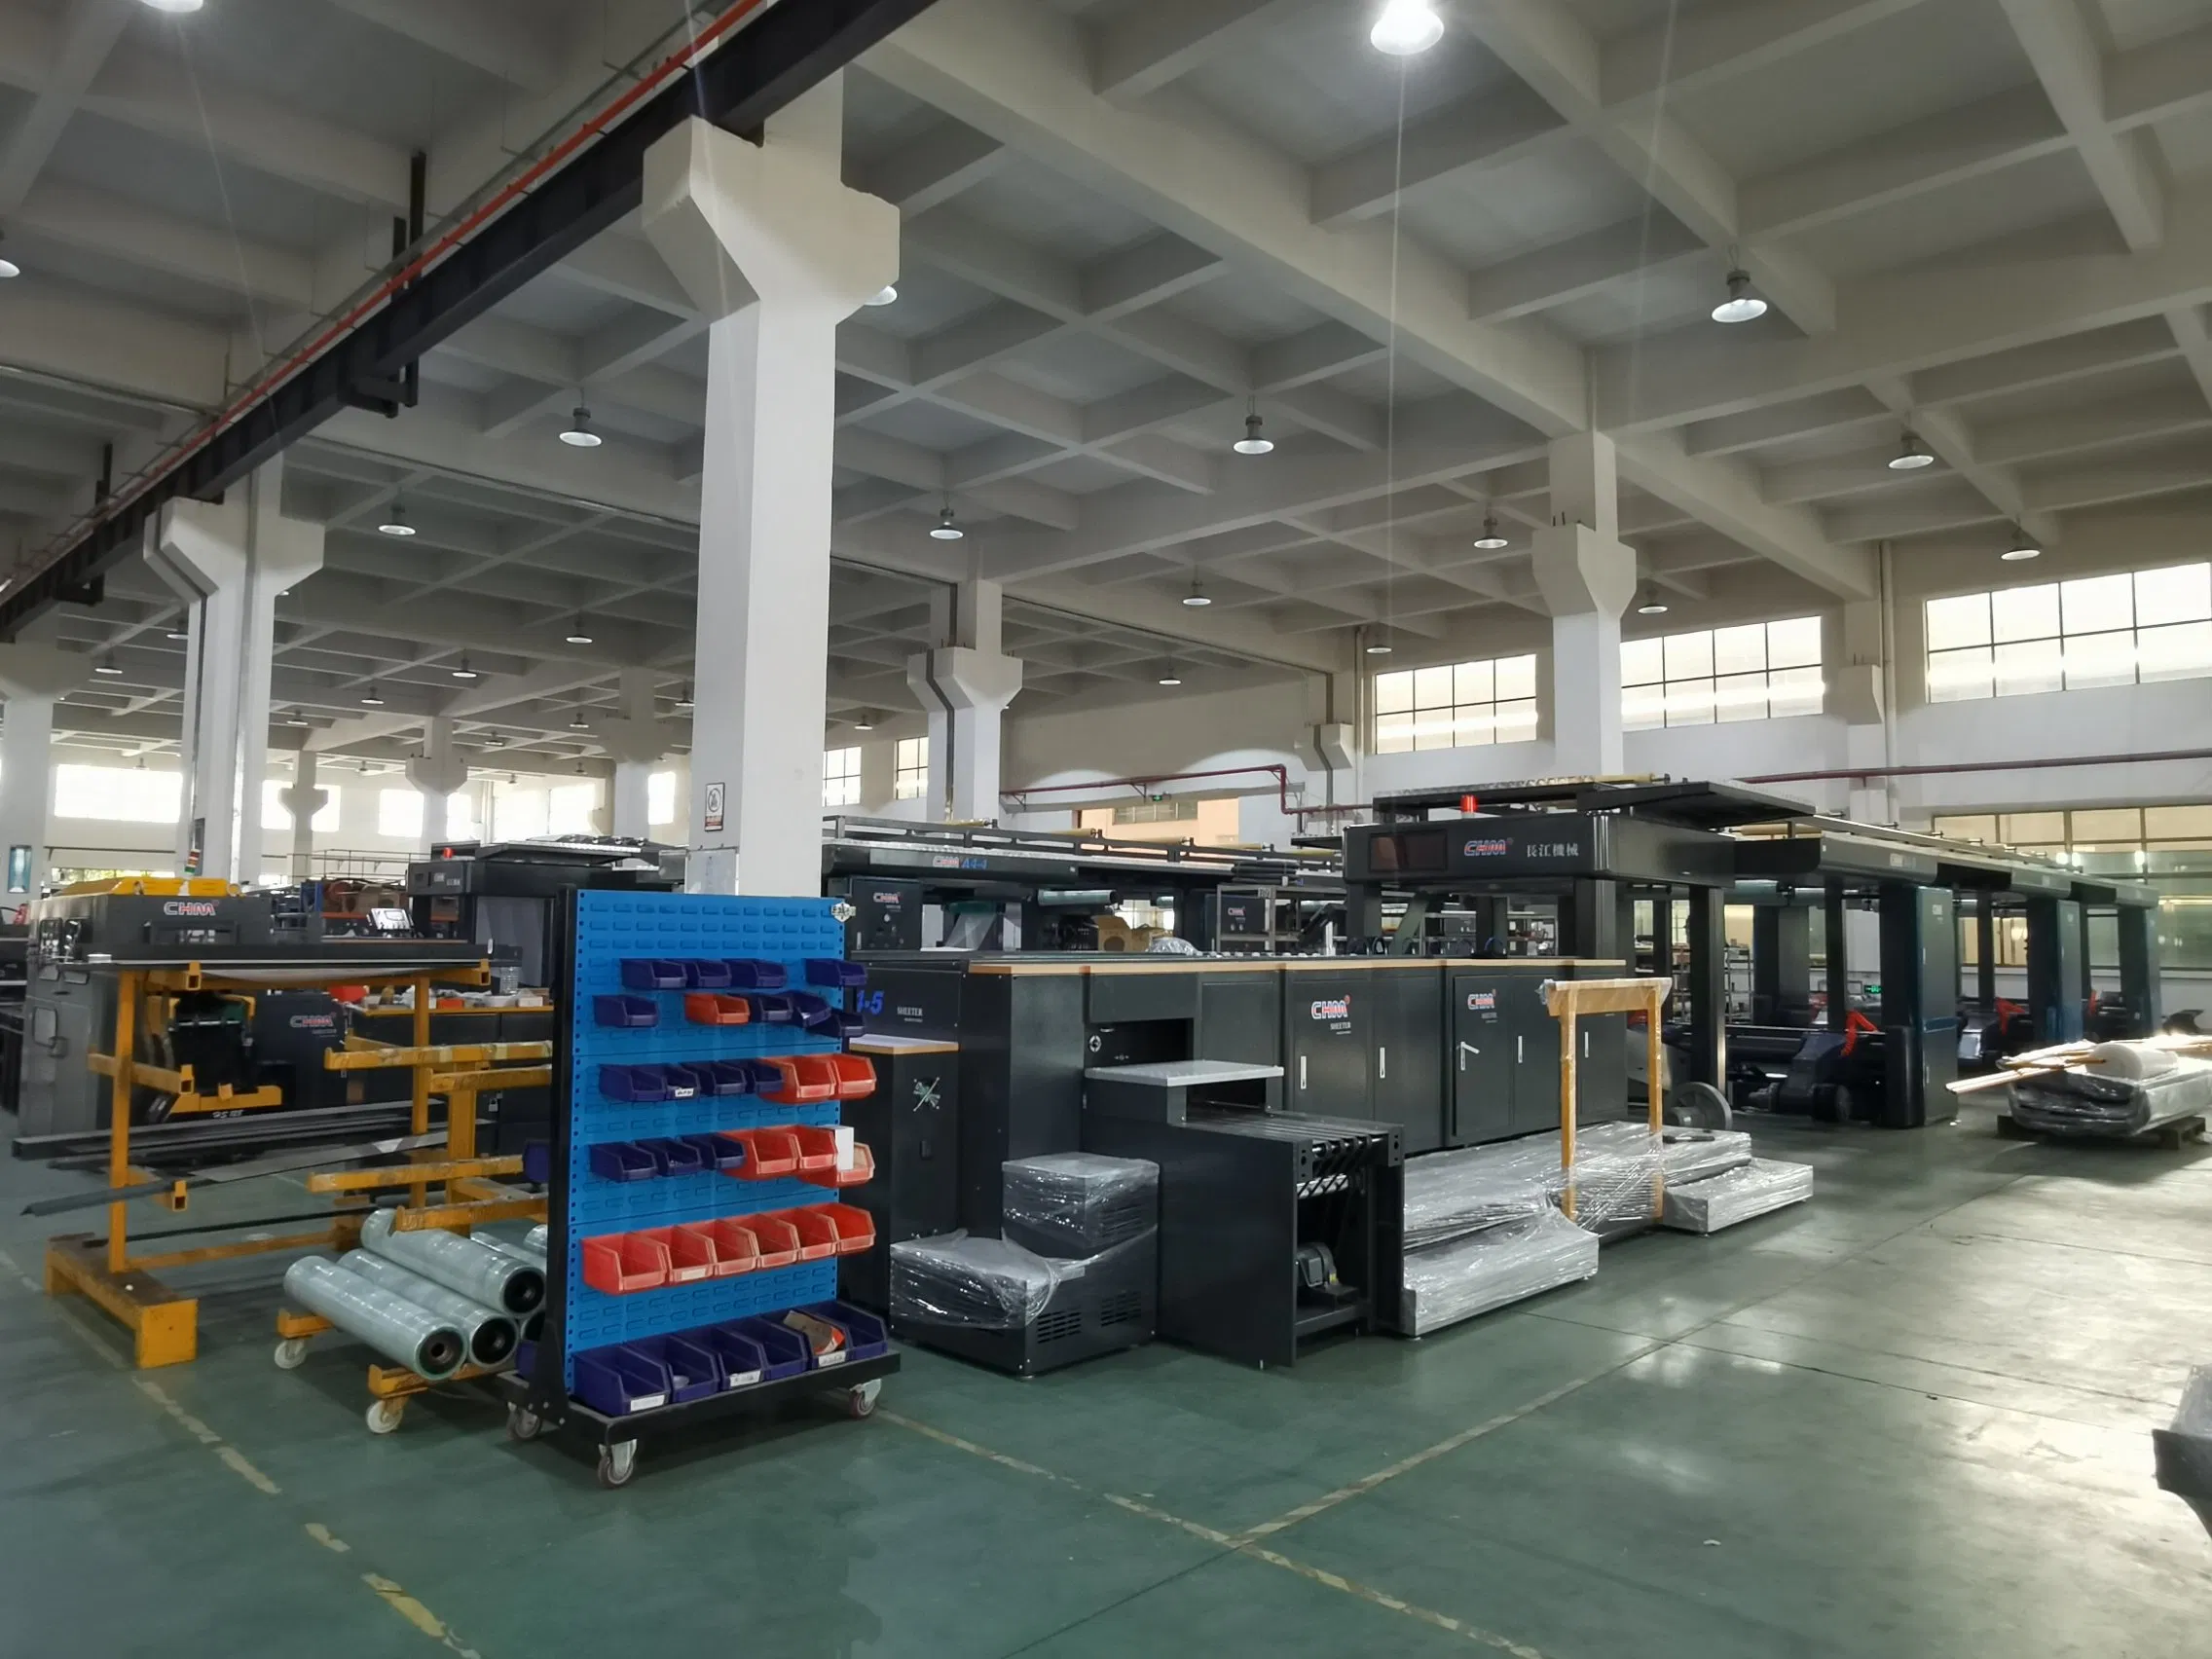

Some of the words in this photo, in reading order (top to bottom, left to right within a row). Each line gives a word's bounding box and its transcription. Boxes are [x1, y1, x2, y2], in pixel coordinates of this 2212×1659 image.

[1464, 840, 1506, 856] CHM
[164, 902, 216, 915] CHM
[1310, 1000, 1348, 1019] CHM
[1467, 993, 1495, 1010] CHM
[290, 1015, 334, 1027] CHM
